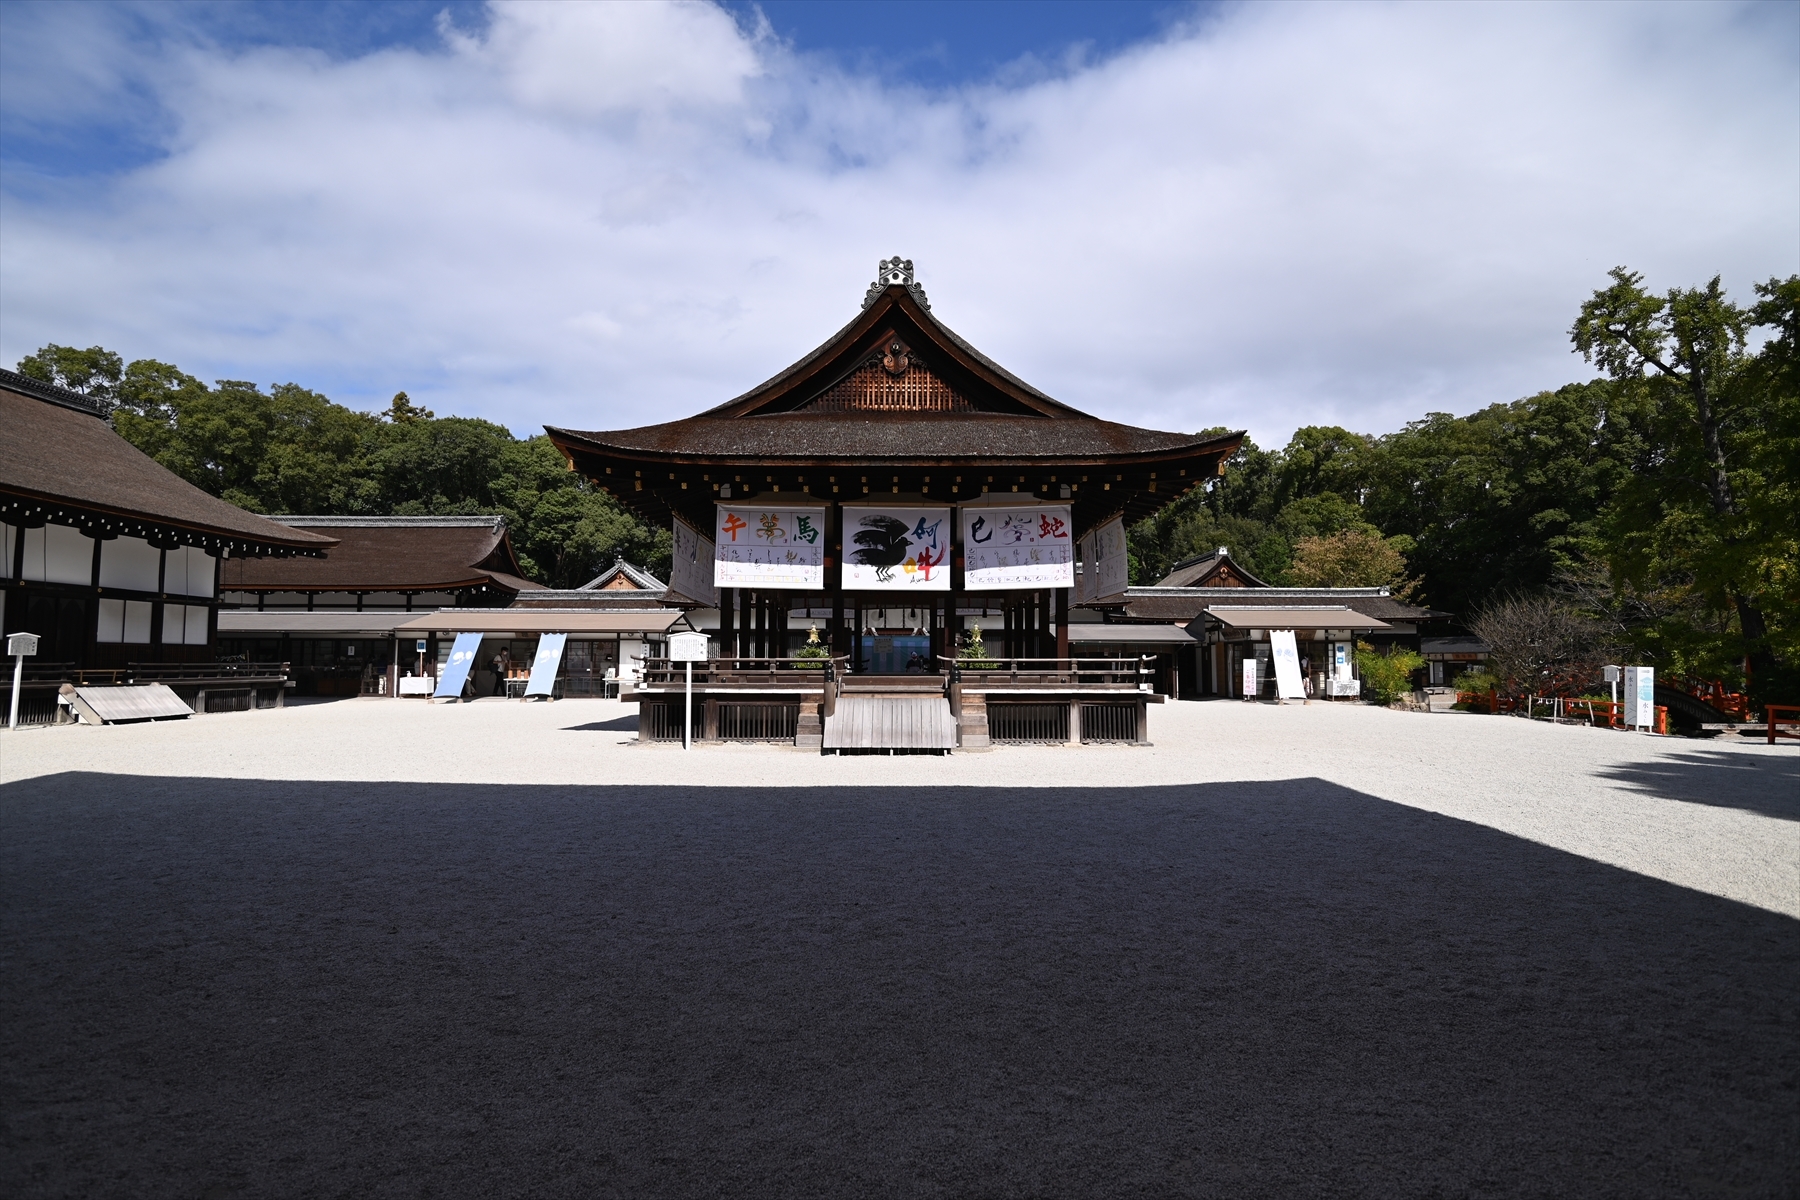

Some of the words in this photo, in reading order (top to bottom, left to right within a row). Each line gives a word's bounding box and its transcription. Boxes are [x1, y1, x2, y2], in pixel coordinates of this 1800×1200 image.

[721, 513, 747, 542] 午
[793, 515, 820, 545] 馬
[1038, 513, 1068, 539] 蛇
